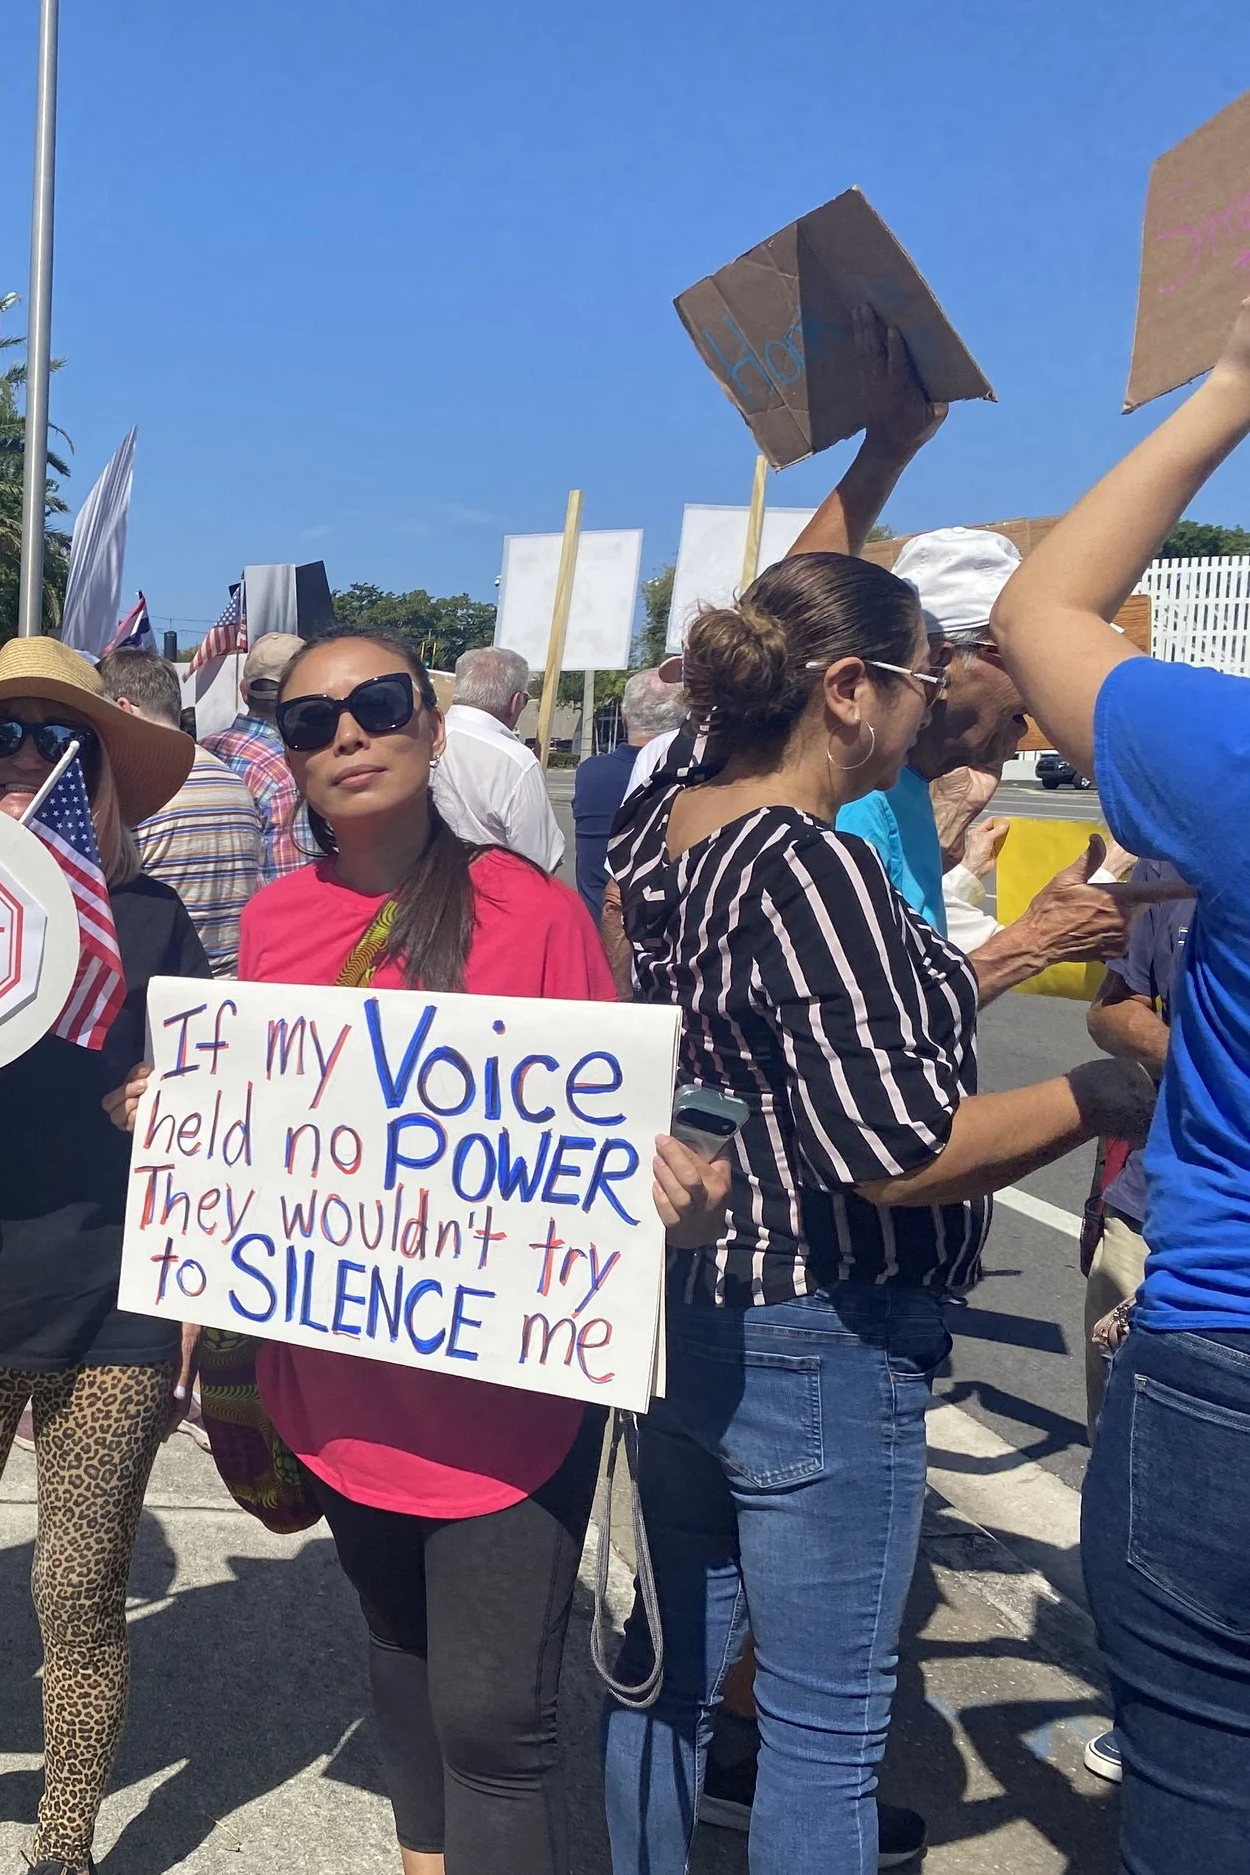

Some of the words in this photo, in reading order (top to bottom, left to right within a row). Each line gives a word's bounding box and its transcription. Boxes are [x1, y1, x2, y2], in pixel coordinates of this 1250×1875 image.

[160, 999, 237, 1080] If
[266, 1015, 353, 1109] my
[363, 996, 628, 1127] Voice
[143, 1080, 254, 1167] held
[285, 1123, 363, 1178] no
[383, 1112, 642, 1226] POWER
[133, 1163, 256, 1245] They
[279, 1183, 507, 1270] wouldn't
[528, 1217, 622, 1318] try
[150, 1237, 208, 1305] to
[227, 1232, 497, 1362] SILENCE
[517, 1312, 616, 1384] me
